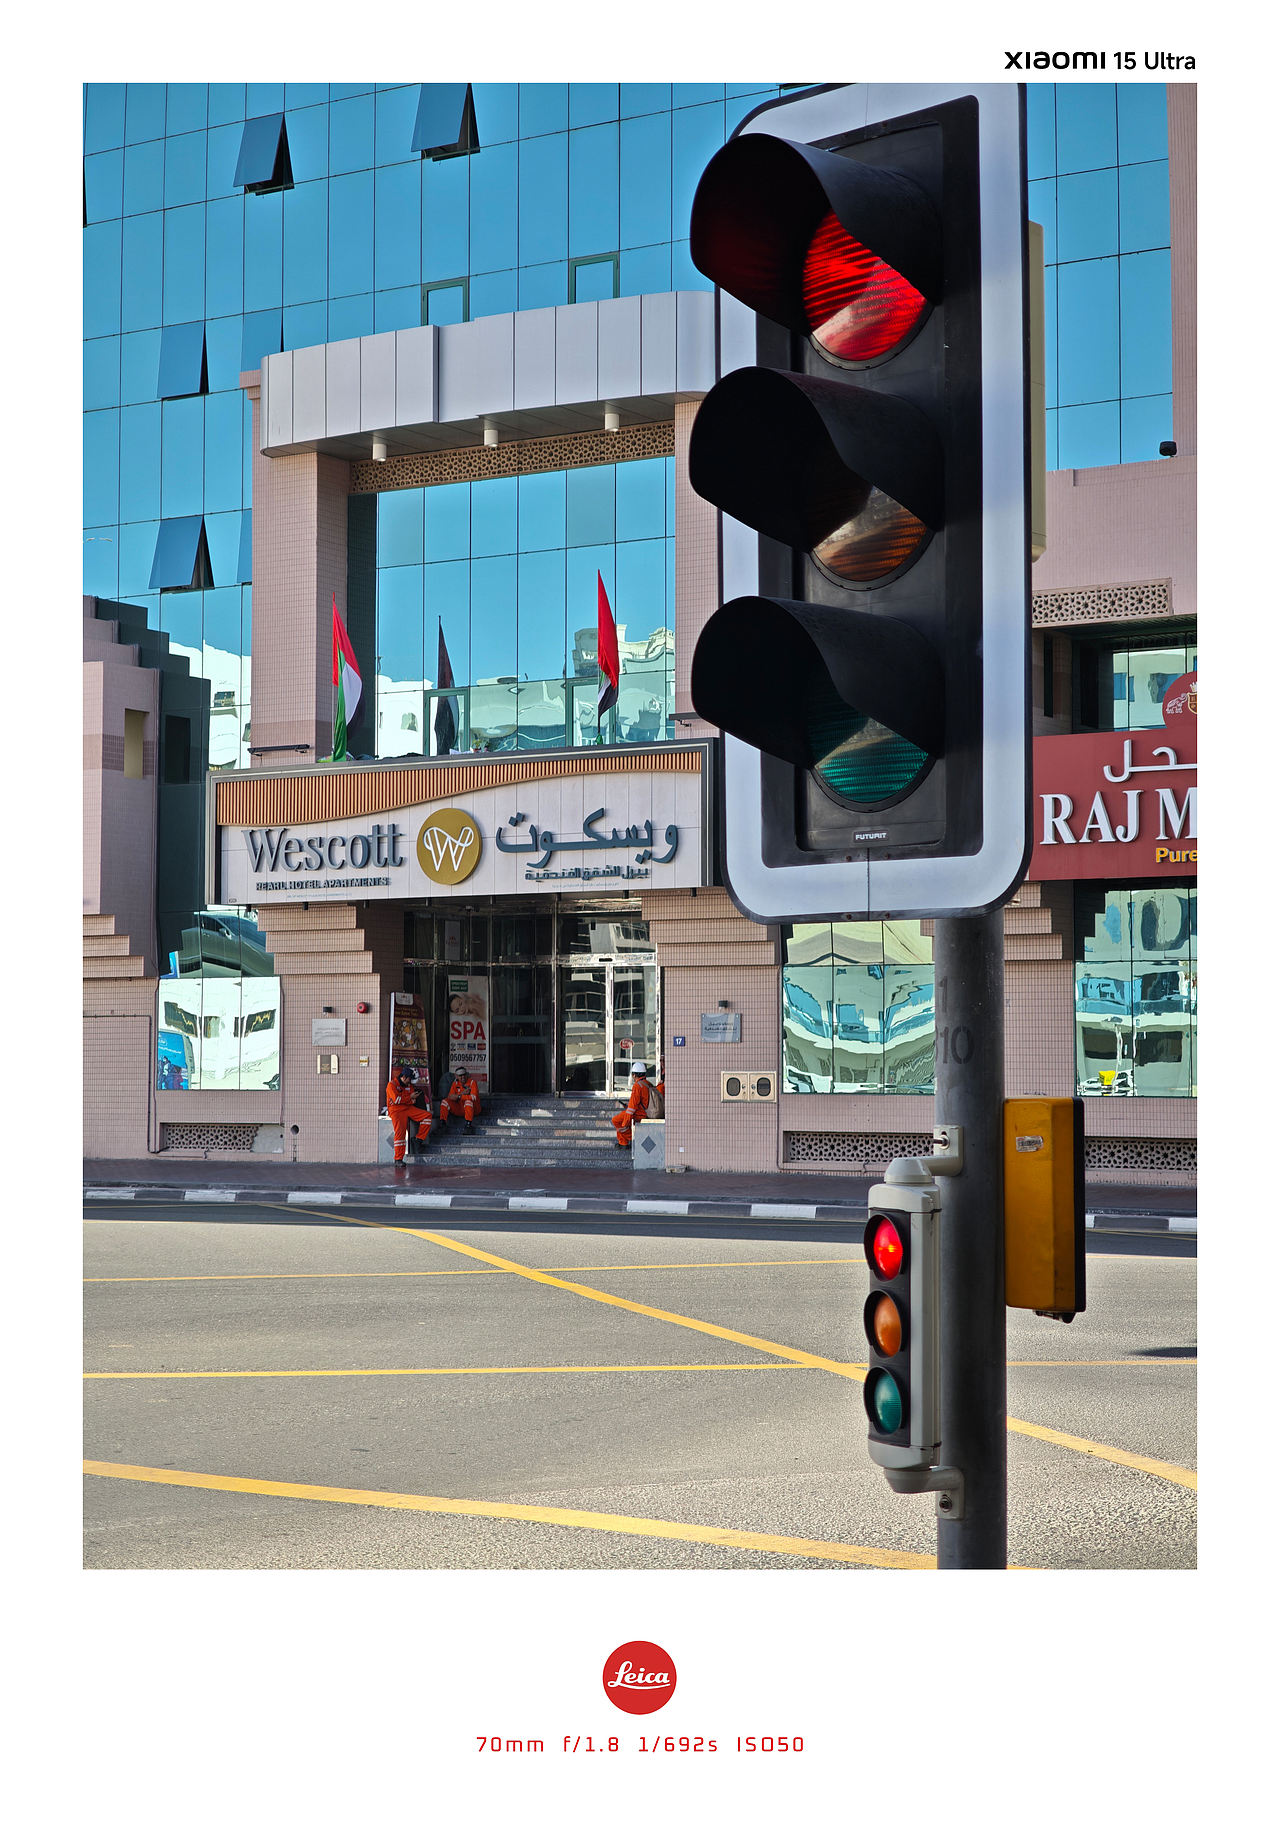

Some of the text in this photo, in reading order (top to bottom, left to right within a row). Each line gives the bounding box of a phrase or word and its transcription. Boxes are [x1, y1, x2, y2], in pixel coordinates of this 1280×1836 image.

[1103, 738, 1197, 783] حل
[1040, 788, 1144, 845] RAJ
[495, 807, 680, 869] ويسكوت
[855, 832, 887, 841] FUTURIT
[241, 823, 407, 872] Wescott
[1155, 846, 1197, 863] Pure
[256, 877, 392, 891] PEARL HOTEL APARTMENTS
[450, 1021, 486, 1040] SPA
[675, 1037, 683, 1045] 17
